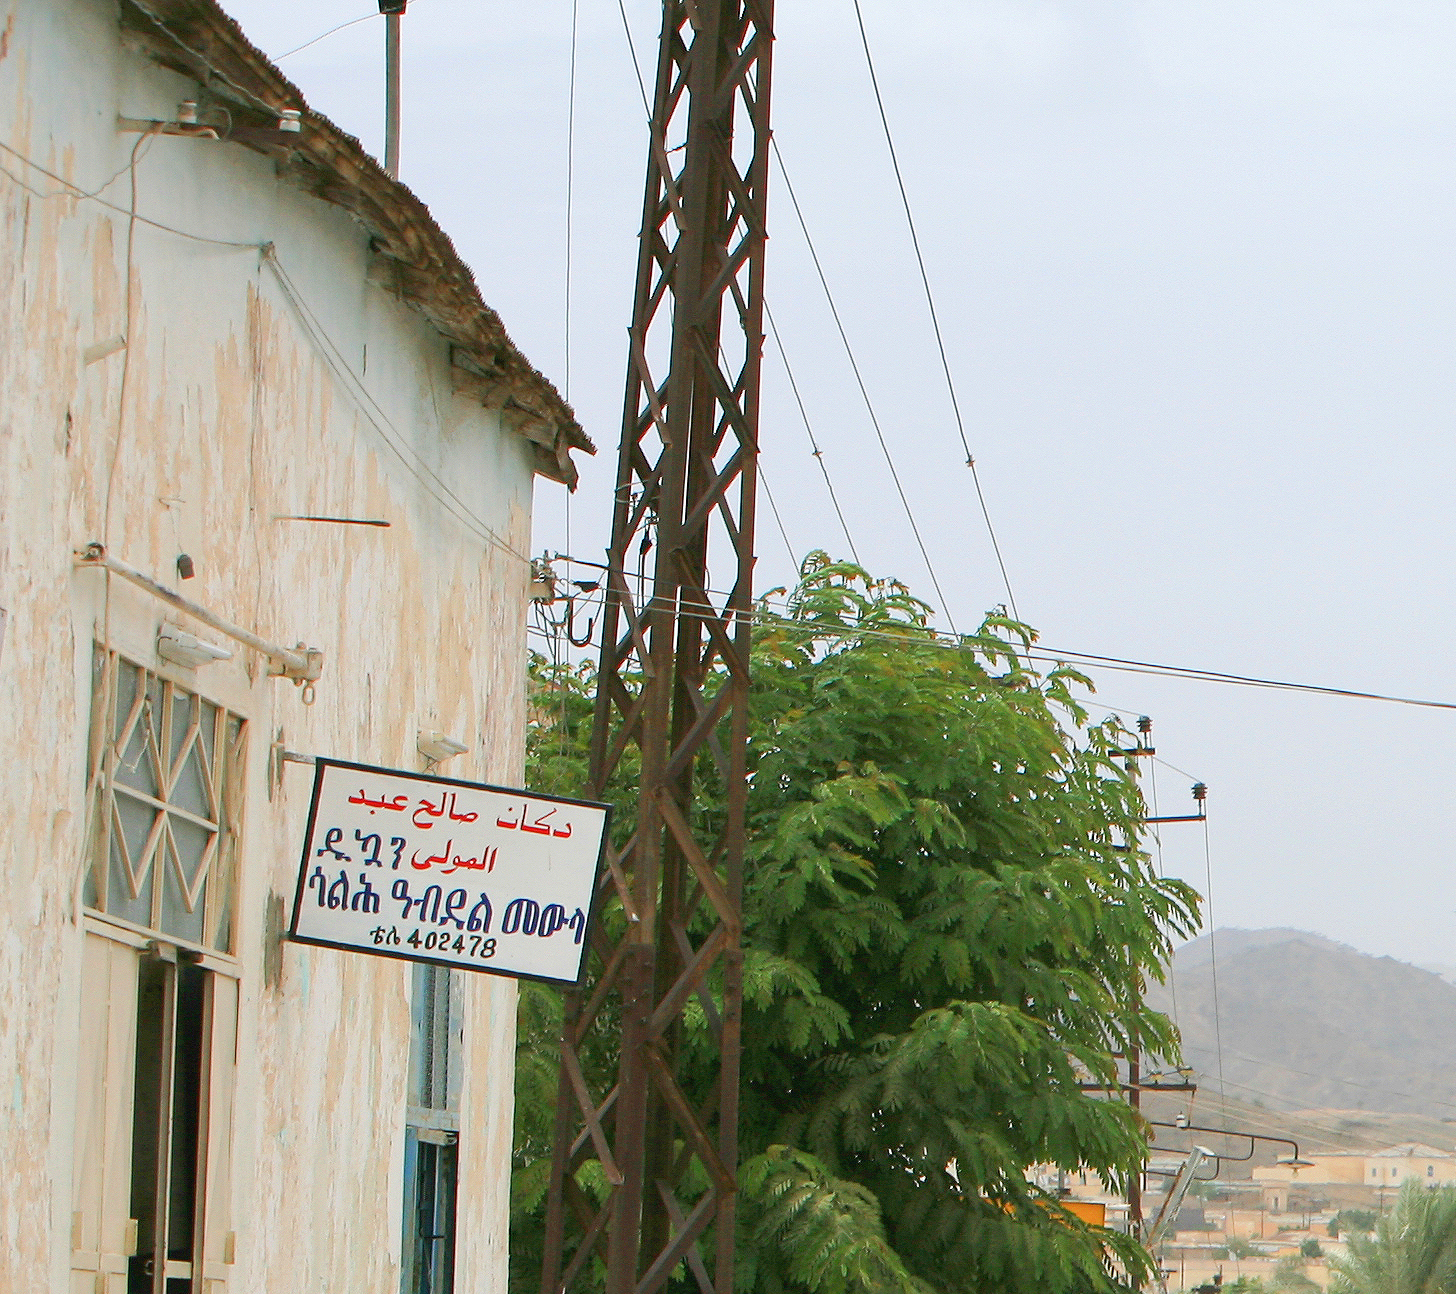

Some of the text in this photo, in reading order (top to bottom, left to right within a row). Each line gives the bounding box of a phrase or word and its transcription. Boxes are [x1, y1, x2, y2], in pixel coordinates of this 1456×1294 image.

[347, 788, 574, 839] دكان صالح عبد
[406, 927, 498, 959] 402478
